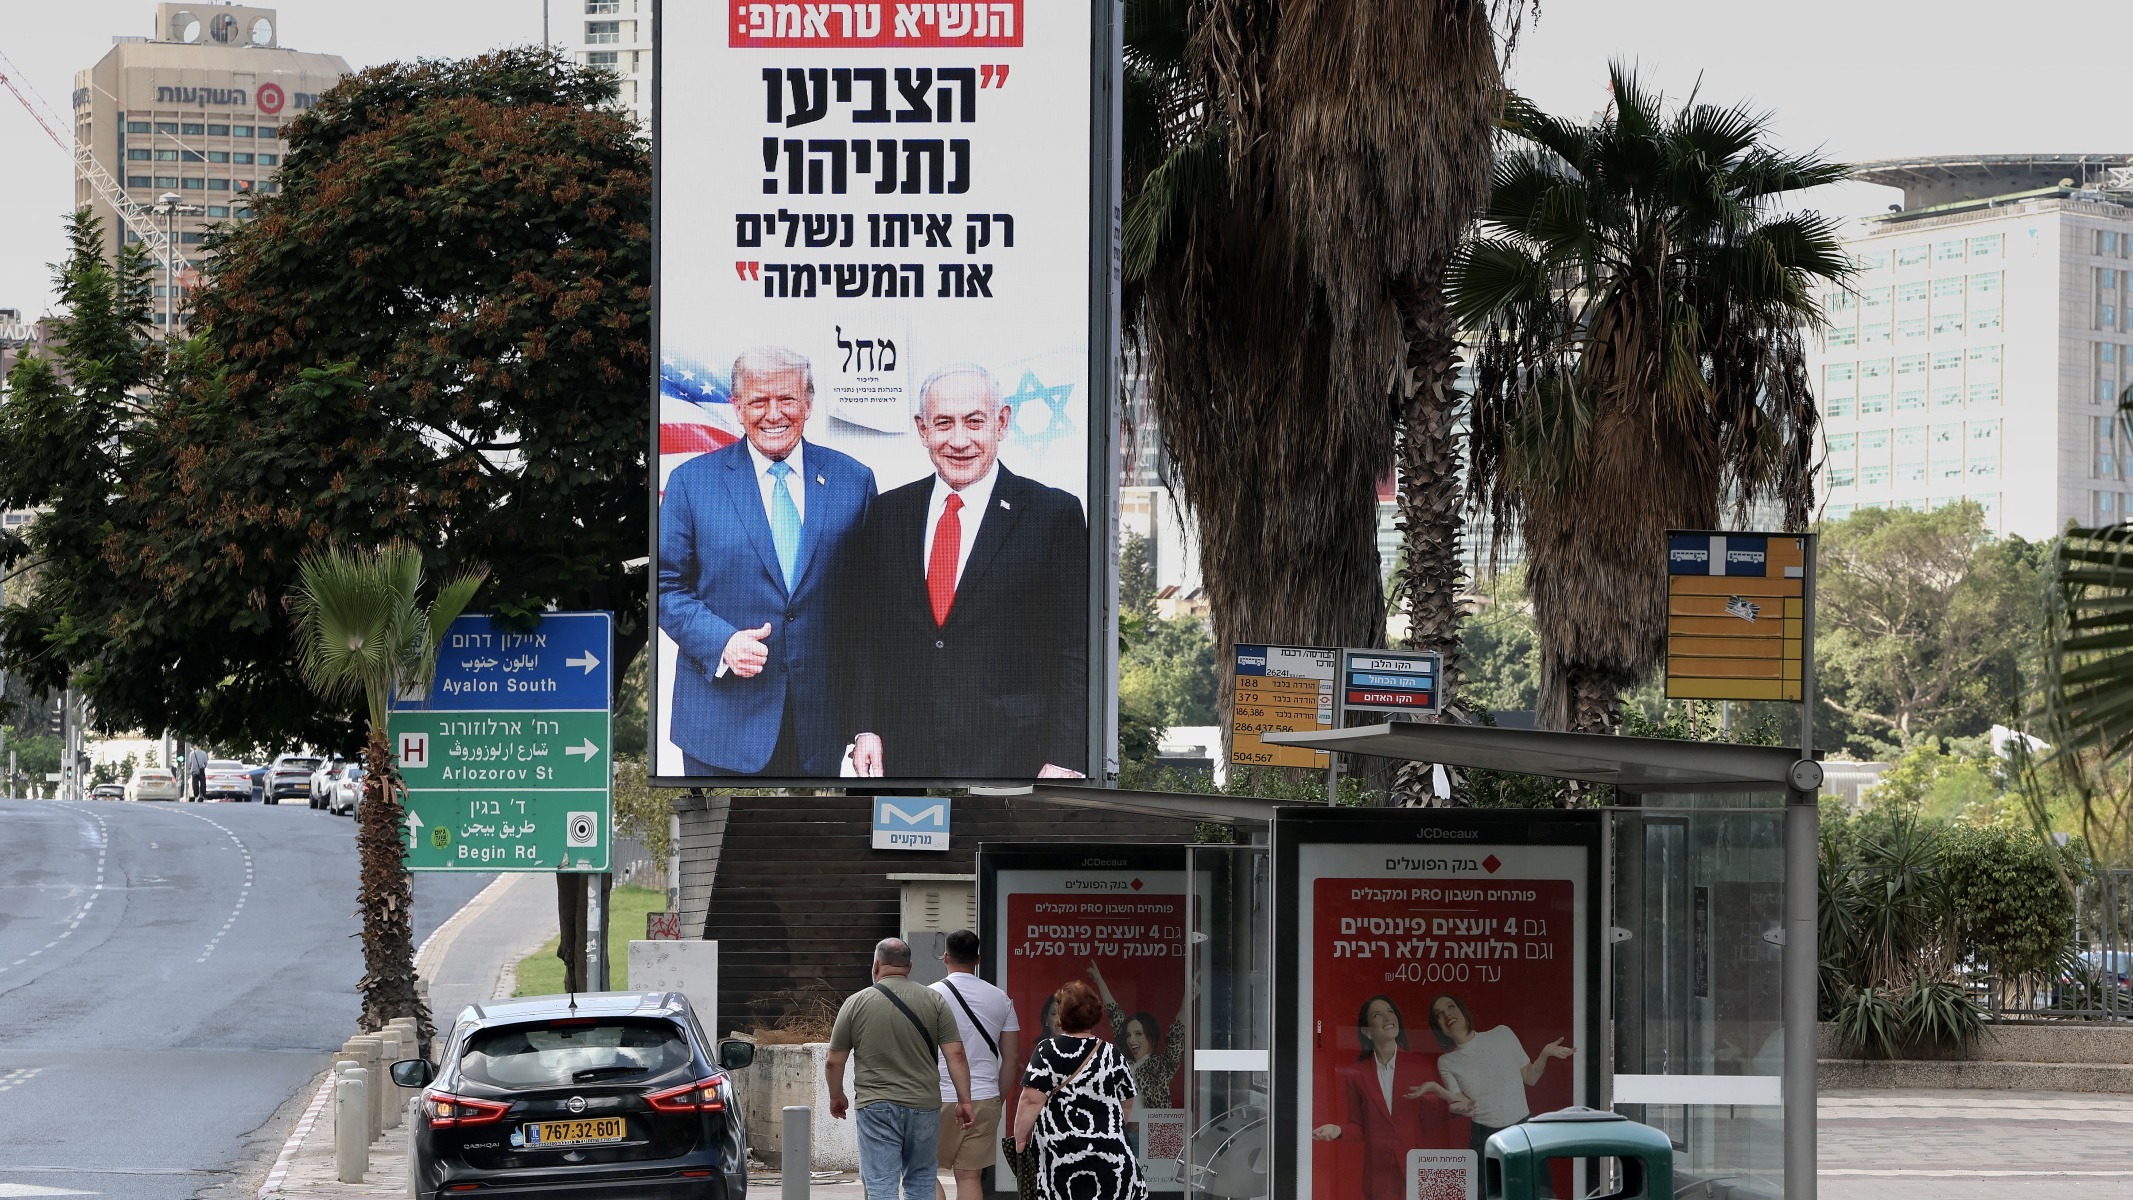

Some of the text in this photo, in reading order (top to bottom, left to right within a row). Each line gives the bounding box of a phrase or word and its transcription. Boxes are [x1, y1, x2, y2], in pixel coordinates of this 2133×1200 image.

[738, 3, 1014, 38] הנשיא טראמפ:
[156, 86, 247, 107] השקעות
[762, 137, 971, 194] נתניהו!
[735, 209, 1014, 254] רק איתו נשלים
[938, 263, 993, 298] את
[0, 323, 38, 341] ADA
[836, 325, 896, 373] מחל
[452, 632, 546, 651] איילון דרום
[461, 654, 538, 673] ايالون جنوب
[1371, 660, 1411, 670] הקו הלבן
[443, 678, 557, 695] Ayalon South
[1241, 679, 1259, 688] 188
[1369, 675, 1416, 687] הקו הכחול
[1238, 693, 1259, 702] 379
[1272, 695, 1291, 703] בלבד
[1364, 694, 1412, 704] הקו האדום
[1236, 708, 1264, 717] 186,386
[439, 718, 521, 735] ארלוזורוב
[517, 742, 548, 761] شارع
[1233, 752, 1273, 763] 504,567
[442, 766, 553, 779] Arlozorov St
[470, 800, 500, 818] בגין
[461, 820, 536, 838] طريق بيجن
[1417, 827, 1479, 839] JCDecaux
[891, 834, 932, 847] מרקעים
[458, 845, 536, 862] Begin Rd
[1082, 858, 1128, 867] JCDecaux
[1385, 857, 1478, 873] בנק הפועלים
[1065, 879, 1128, 890] בנק הפועלים
[1351, 887, 1537, 903] פותחים חשבון PRO ומקבלים
[1035, 903, 1174, 914] פותחים חשבון PRO ומקבלים
[1027, 925, 1181, 939] גם 4 יועצים פיננסיים
[1341, 917, 1547, 936] גם 4 יועצים פיננסיים
[1068, 942, 1090, 956] עד
[1094, 941, 1119, 956] של
[1123, 942, 1167, 958] מענק
[1333, 937, 1553, 960] וגם הלוואה ללא ריבית
[1475, 965, 1501, 982] עד
[532, 1129, 539, 1138] IL
